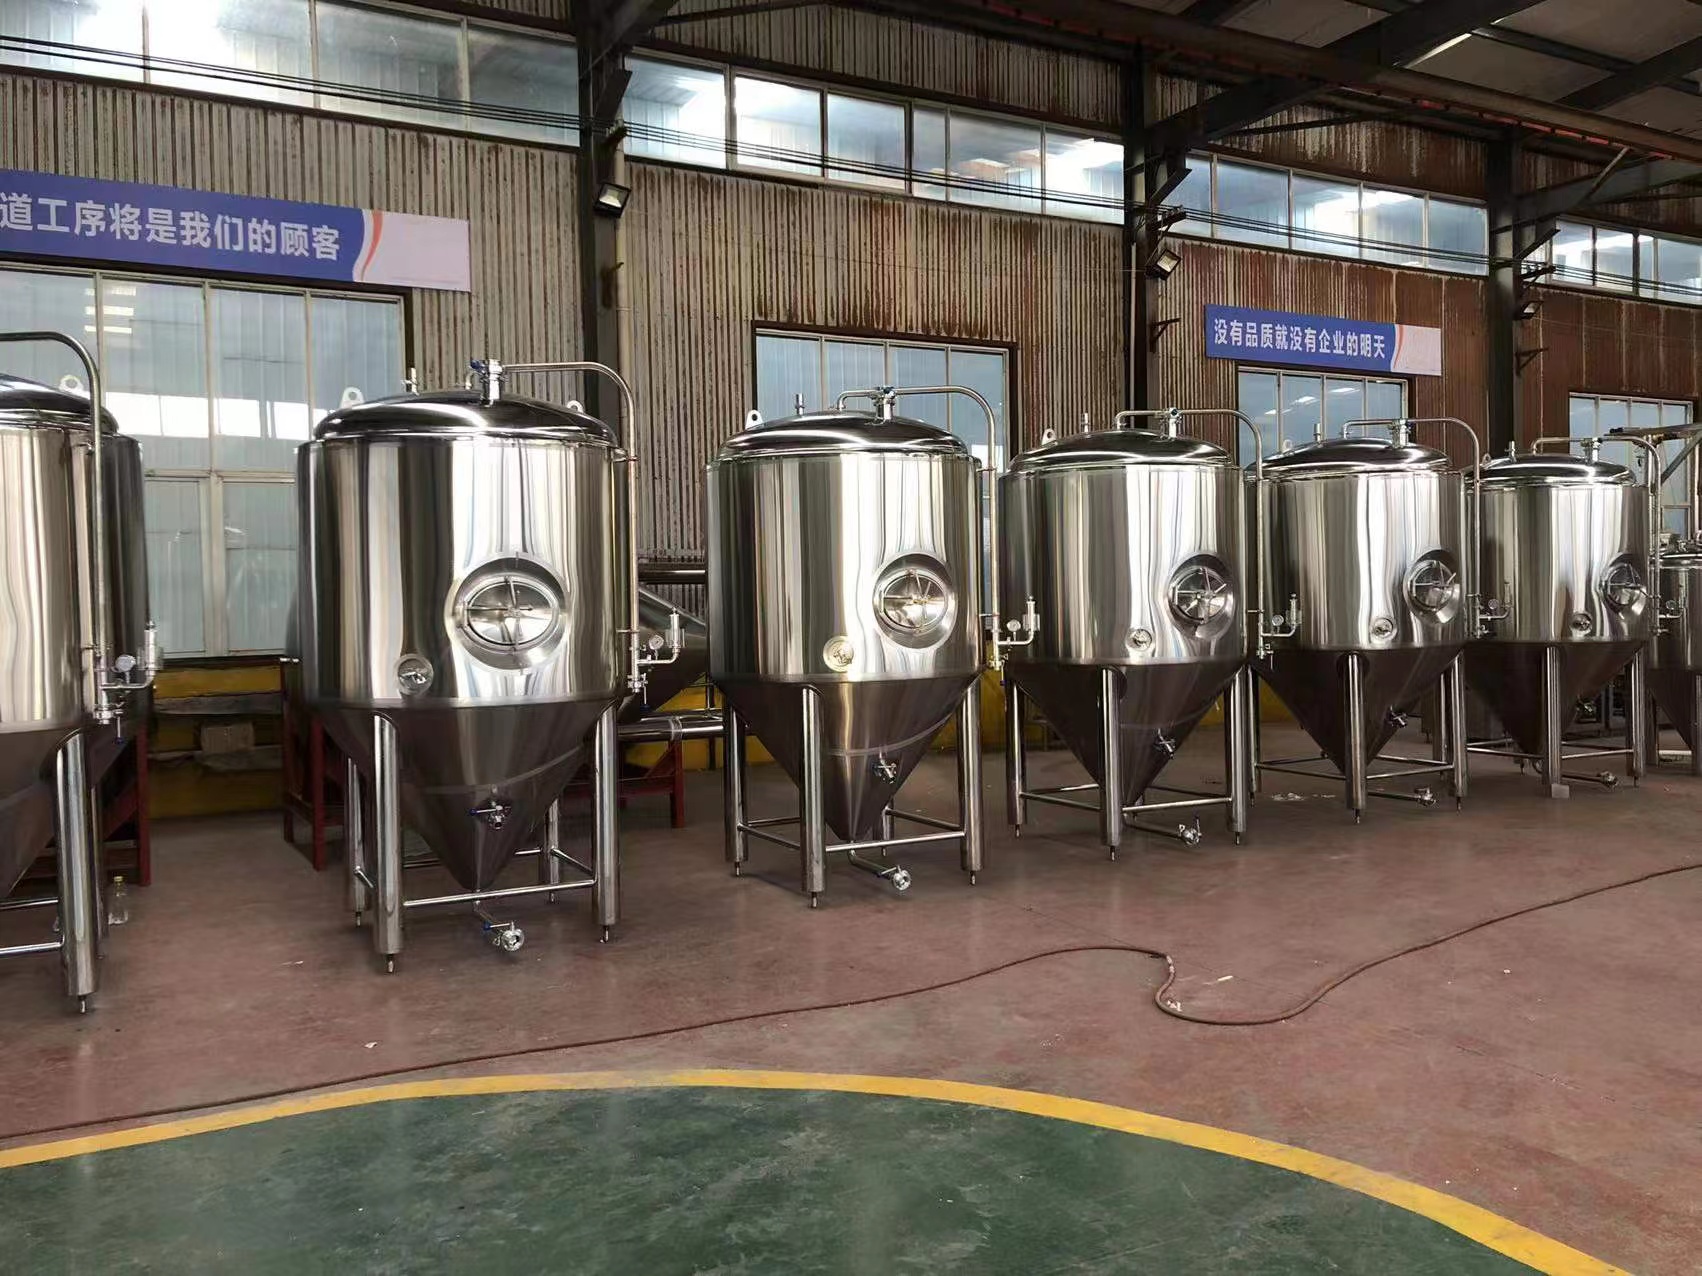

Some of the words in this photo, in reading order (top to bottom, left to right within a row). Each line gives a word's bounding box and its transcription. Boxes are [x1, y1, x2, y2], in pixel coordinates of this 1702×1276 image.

[0, 192, 340, 261] 道工序将是我们的顾客
[1214, 318, 1386, 359] 没有品质就没有企业的明天
